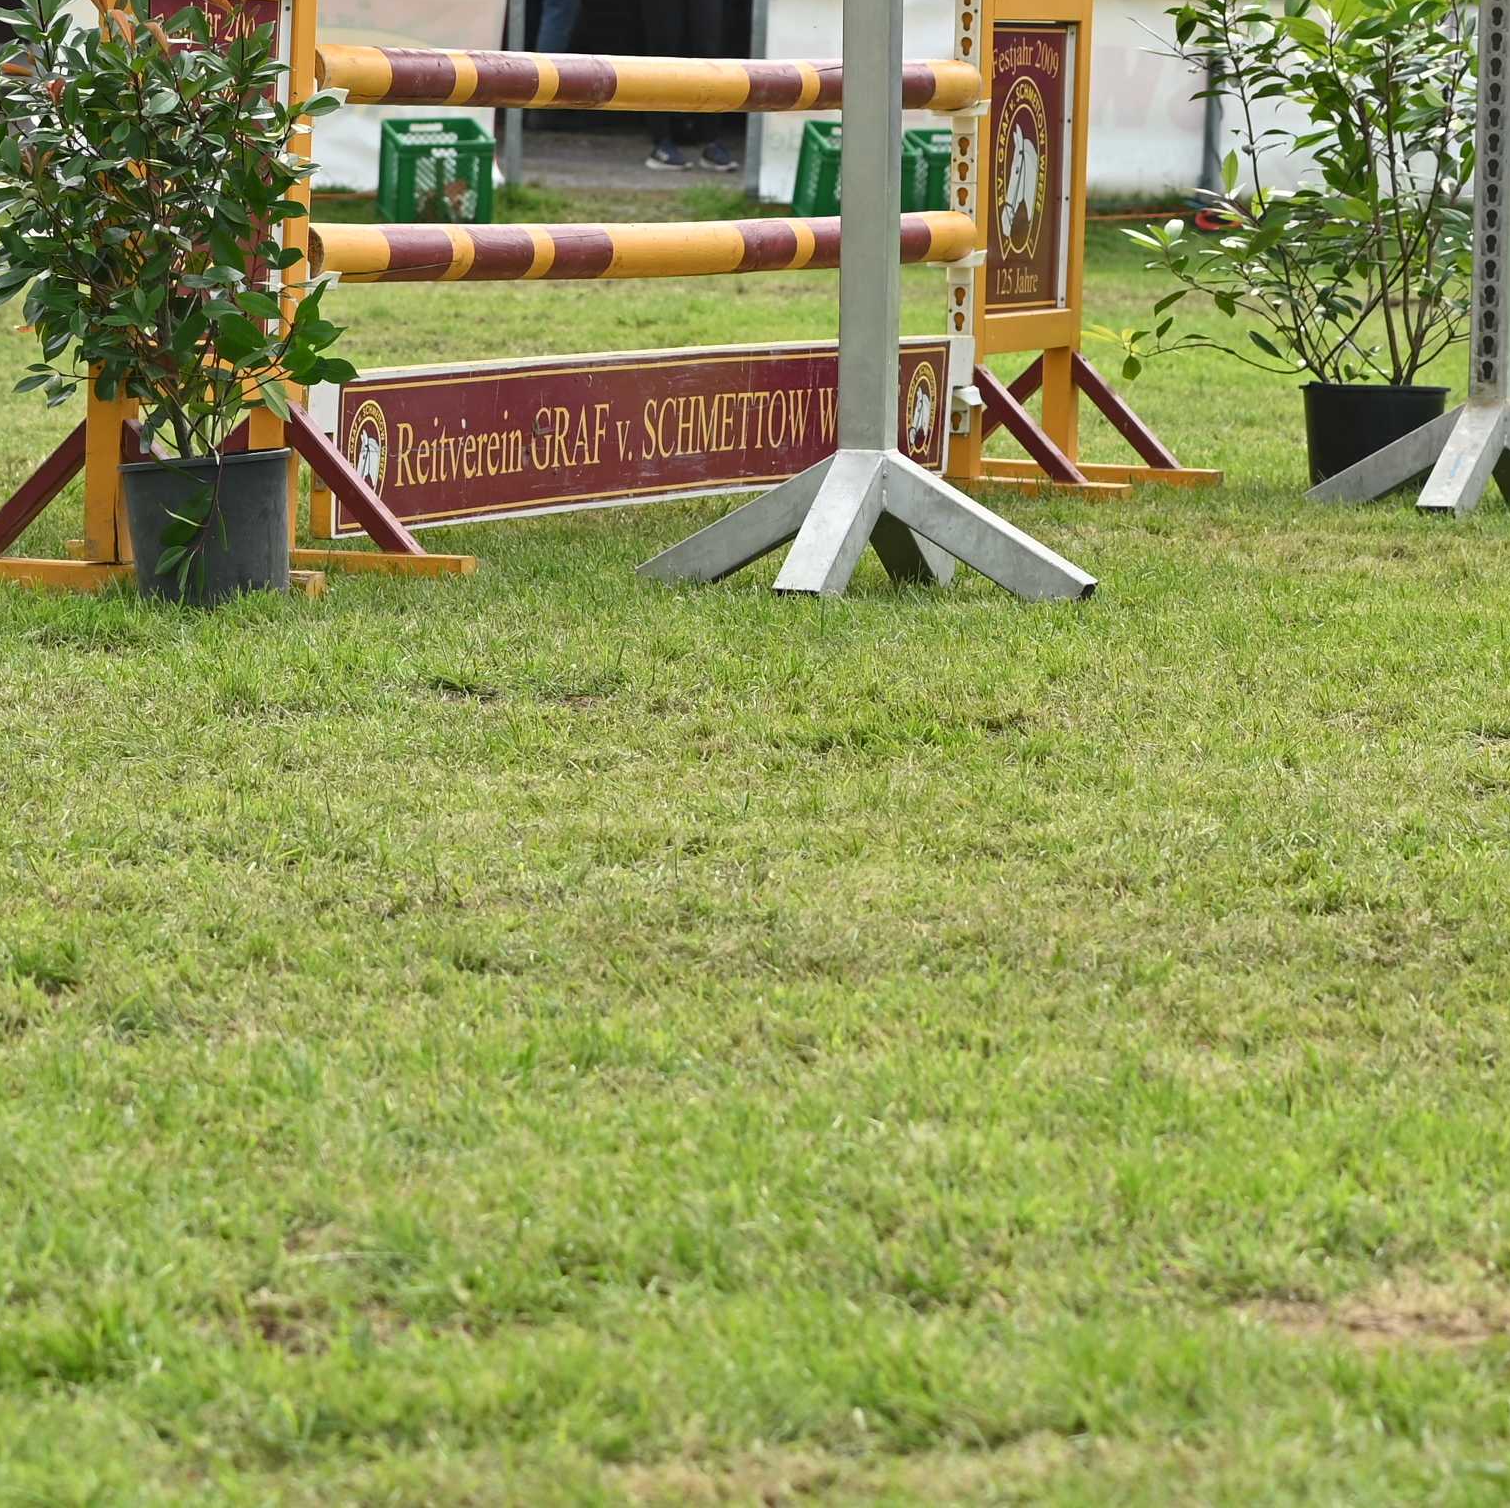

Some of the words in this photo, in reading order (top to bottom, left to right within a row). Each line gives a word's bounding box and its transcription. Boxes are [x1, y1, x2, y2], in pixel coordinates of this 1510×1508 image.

[1035, 39, 1059, 79] 2009
[996, 268, 1012, 294] 125
[1014, 266, 1039, 294] Jahre
[395, 416, 524, 487] Reitverein
[532, 403, 610, 471] GRAF
[616, 421, 633, 463] v.
[642, 389, 813, 459] SCHMETTOW
